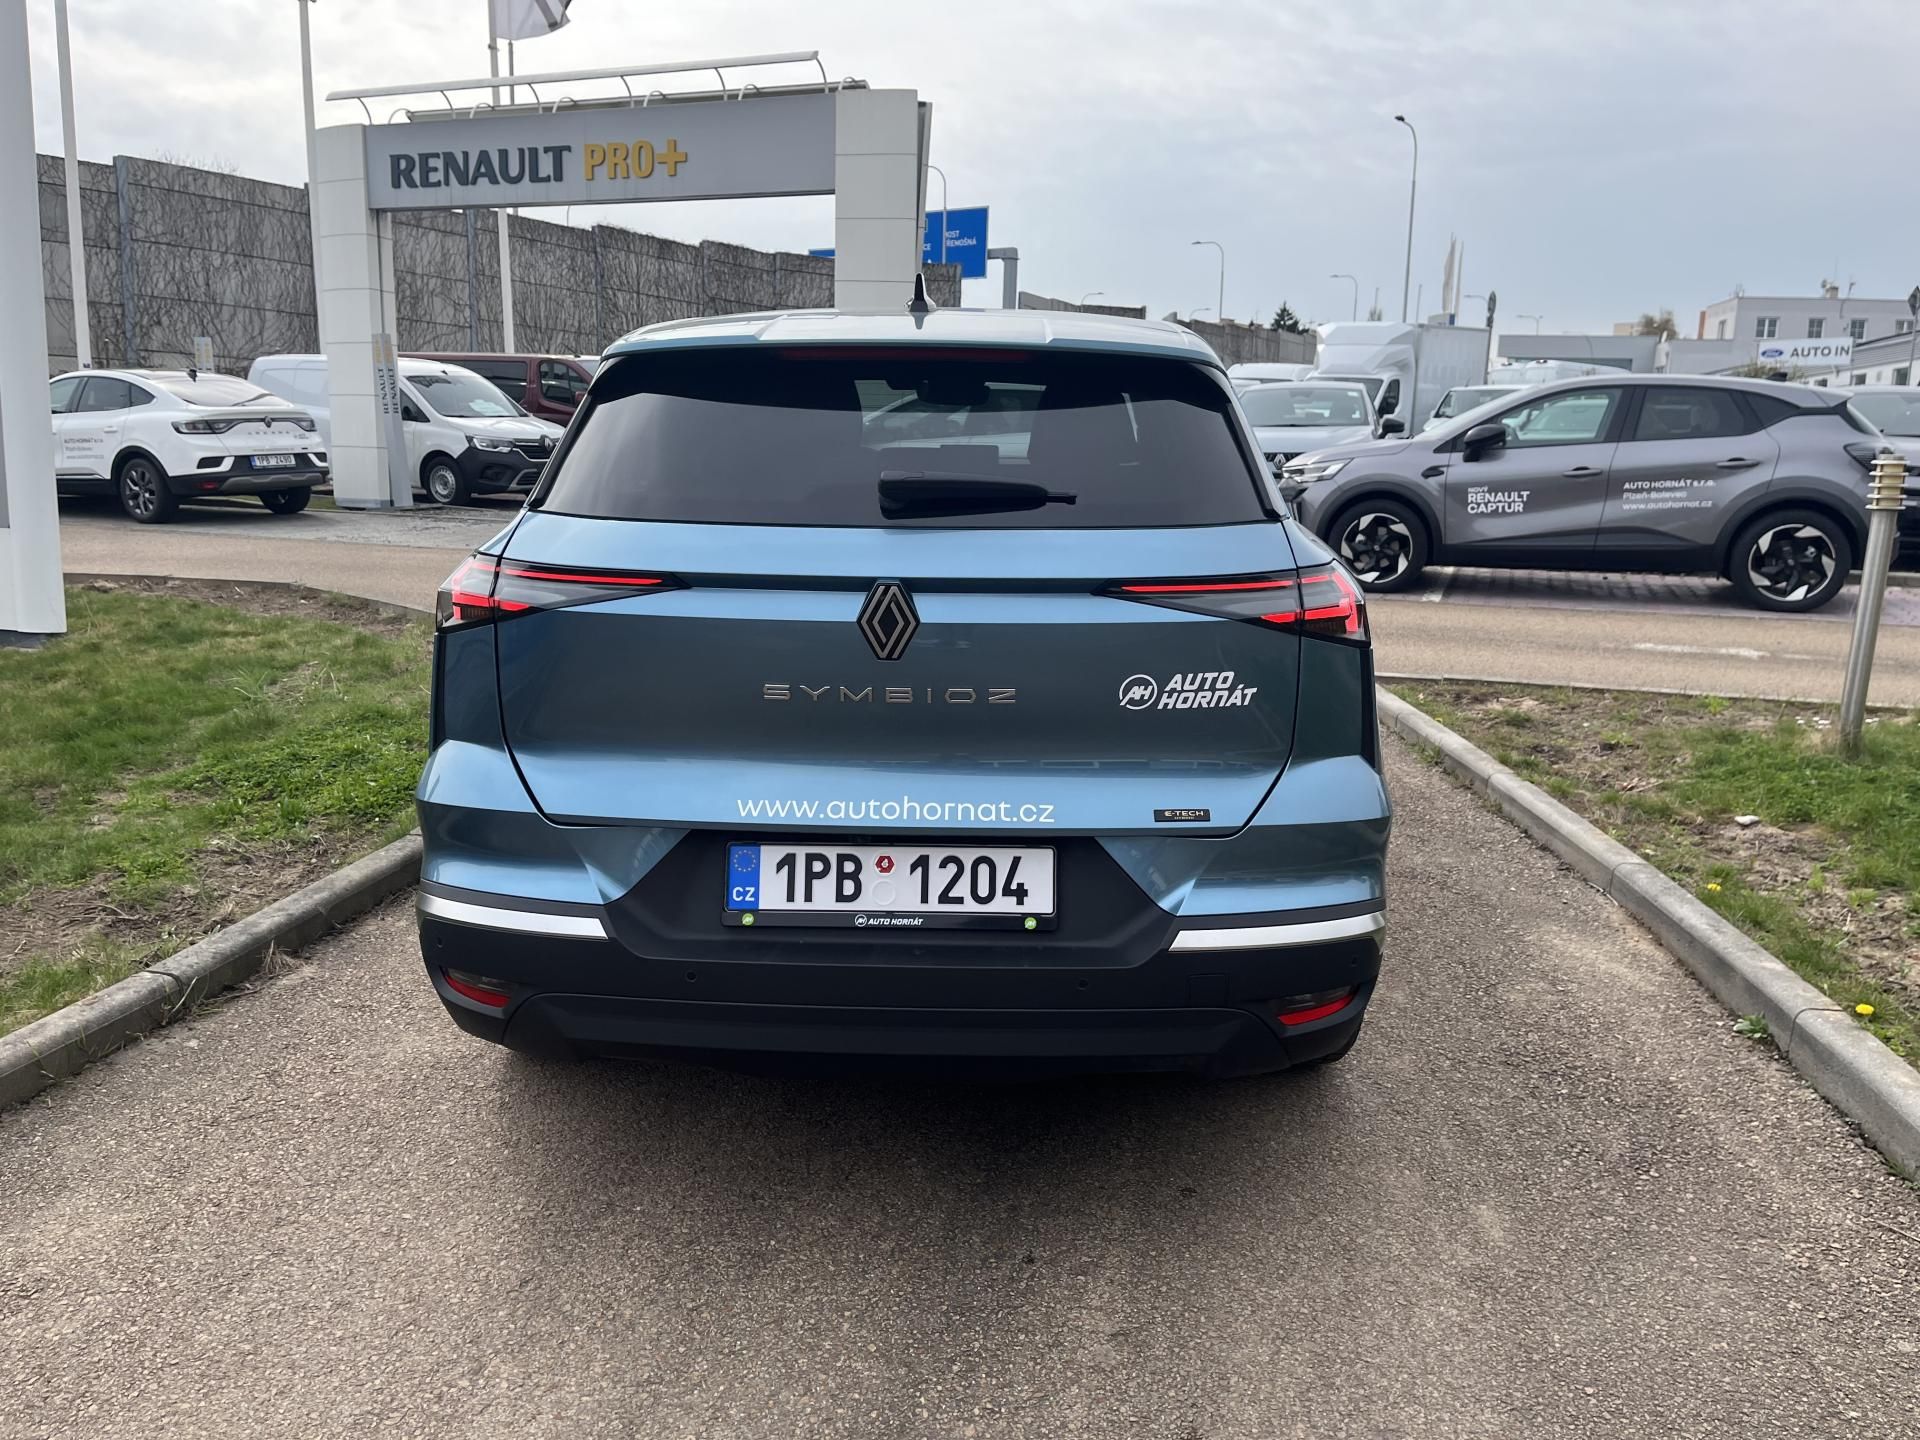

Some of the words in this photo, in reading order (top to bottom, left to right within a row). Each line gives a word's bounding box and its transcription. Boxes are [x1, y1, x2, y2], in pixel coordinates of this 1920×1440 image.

[389, 145, 571, 188] RENAULT
[583, 139, 687, 181] PRO+
[945, 230, 959, 238] OST
[1790, 346, 1832, 358] AUTO
[1835, 345, 1850, 356] IN
[377, 368, 390, 414] RENAULT
[387, 368, 400, 414] RENAULT
[1623, 481, 1650, 490] AUTO
[1651, 478, 1692, 489] HORNÁT
[1468, 491, 1530, 503] RENAULT
[1622, 501, 1713, 510] www.autohornat.cz
[1467, 502, 1524, 514] CAPTUR
[1164, 671, 1235, 691] AUTO
[763, 683, 1017, 704] SYMBIOZ
[1157, 684, 1258, 710] HORNÁT
[737, 796, 1055, 823] www.autohornat.cz
[776, 852, 863, 903] 1PB
[910, 854, 1029, 906] 1204
[732, 887, 755, 901] CZ
[891, 917, 923, 926] HORNÁT
